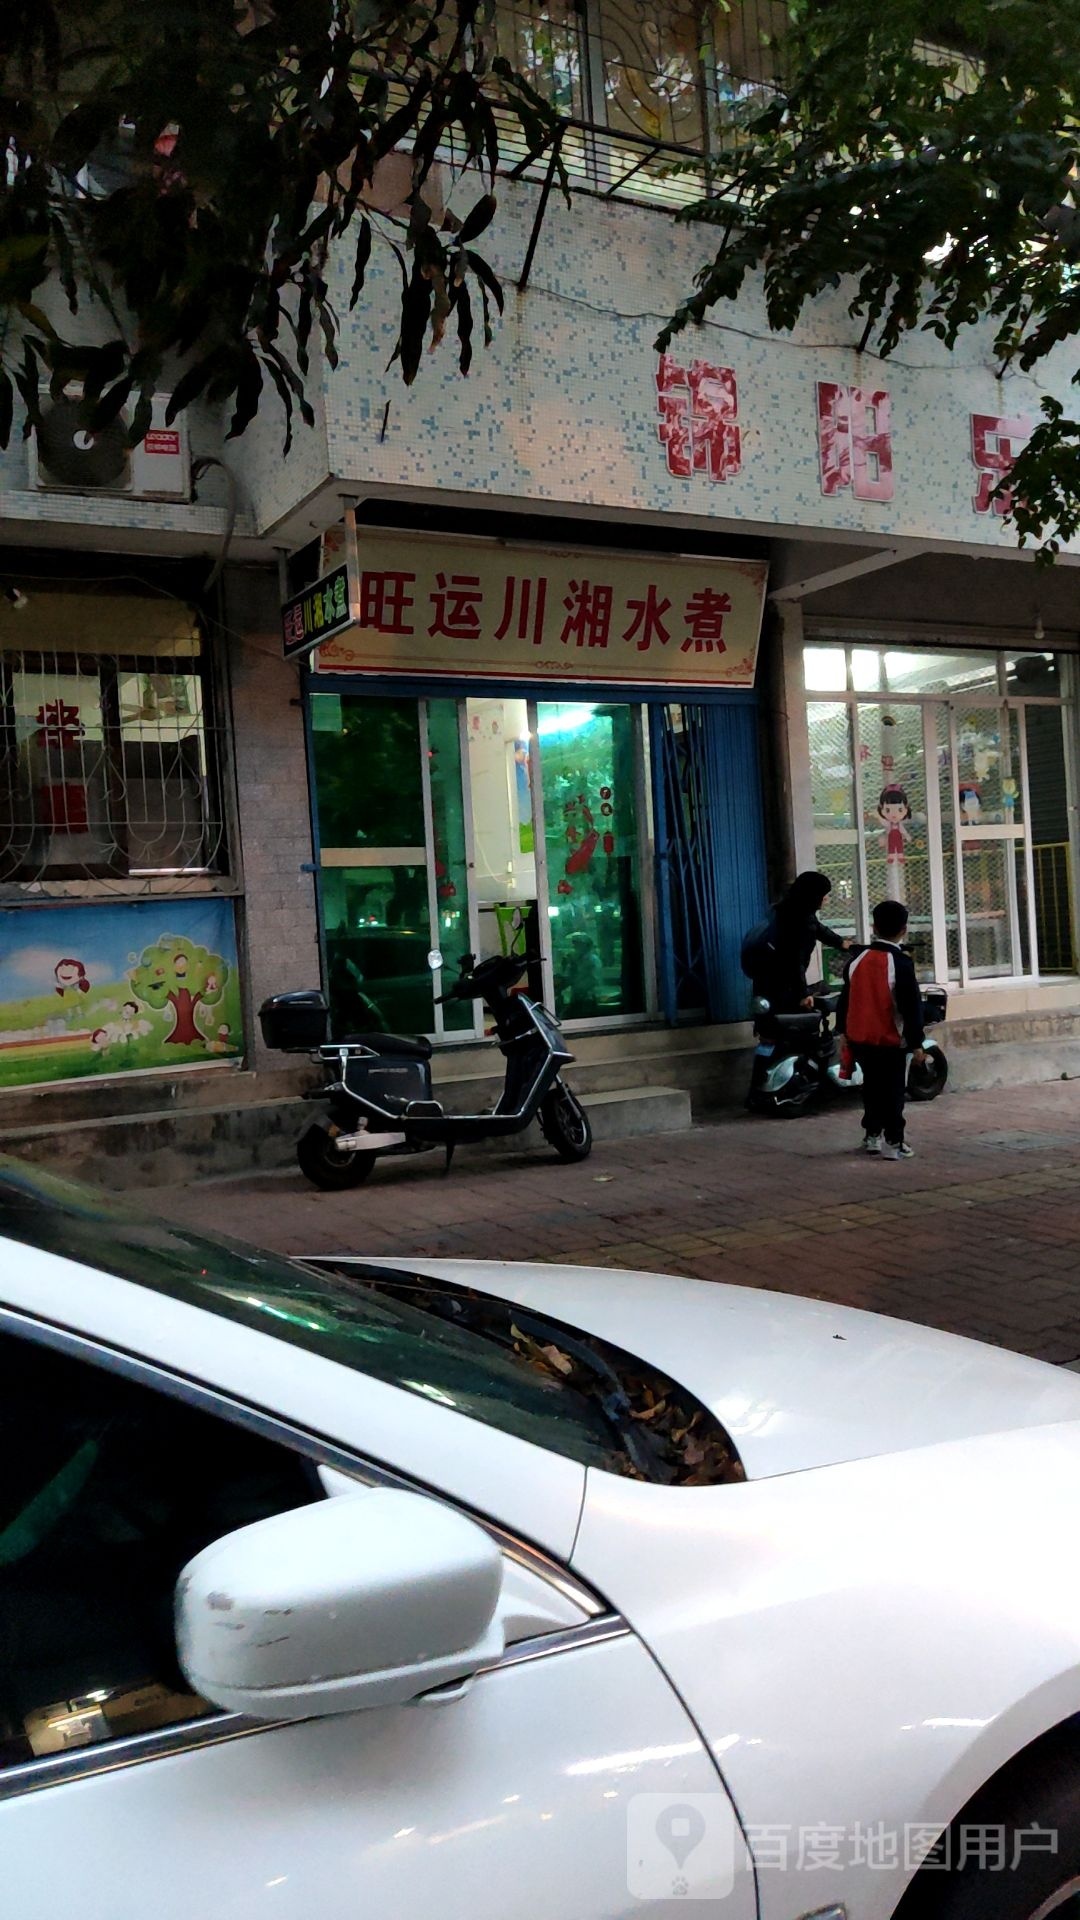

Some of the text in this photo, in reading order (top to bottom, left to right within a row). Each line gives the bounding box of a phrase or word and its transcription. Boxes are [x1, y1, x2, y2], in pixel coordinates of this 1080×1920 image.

[360, 571, 732, 654] 旺运川湘水煮
